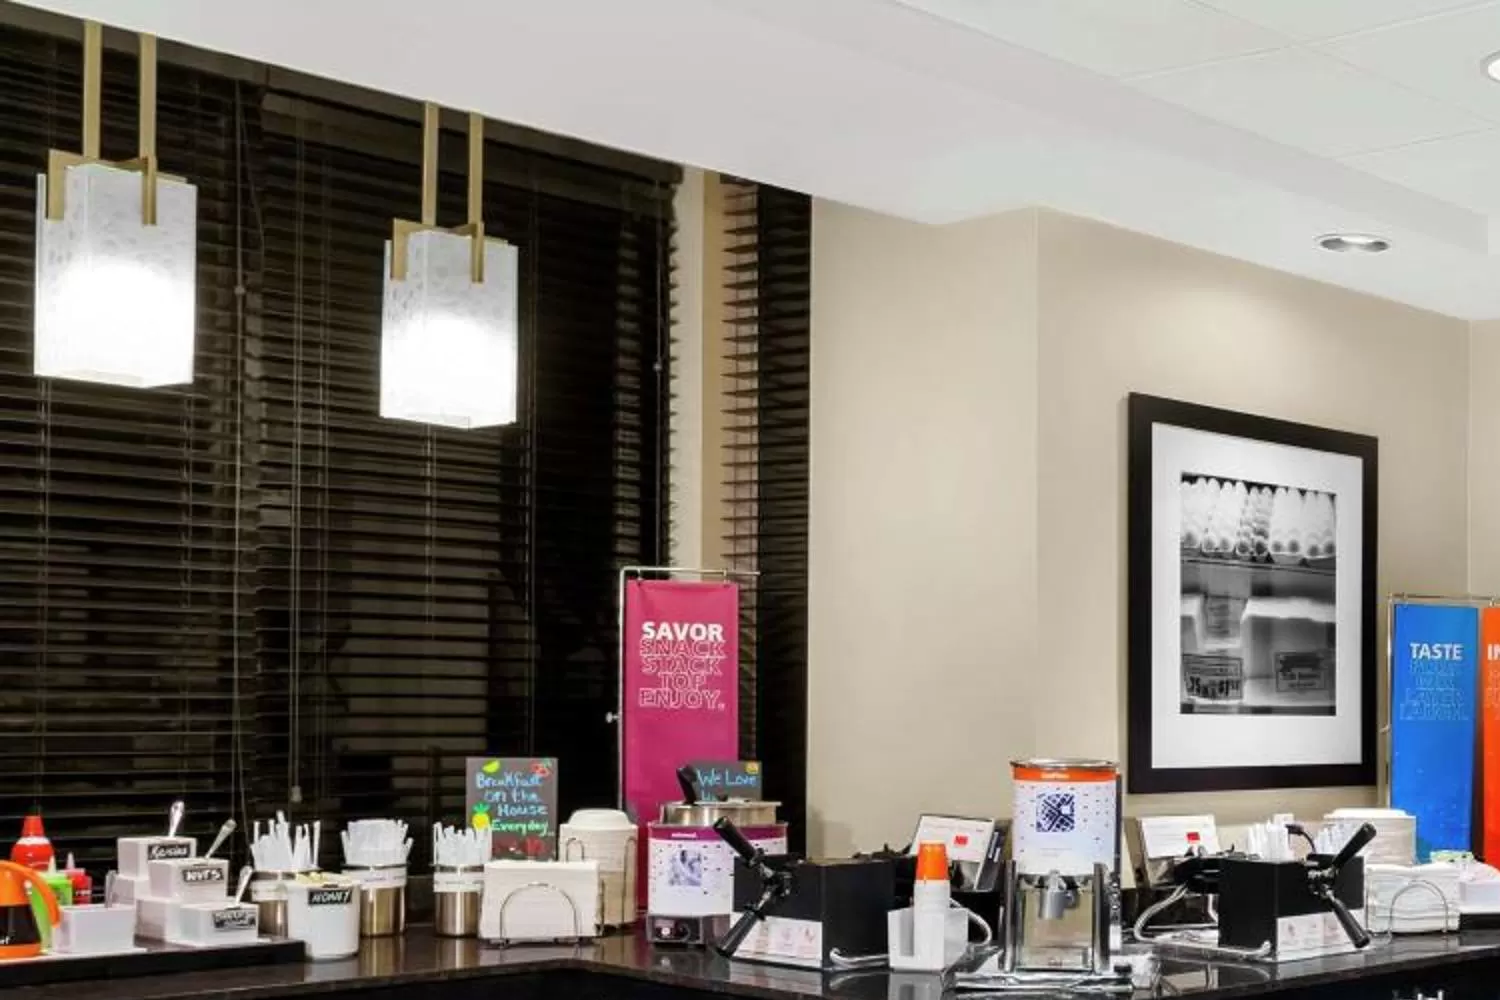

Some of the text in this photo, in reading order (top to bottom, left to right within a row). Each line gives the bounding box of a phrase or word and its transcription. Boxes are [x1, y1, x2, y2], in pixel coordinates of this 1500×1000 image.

[641, 621, 725, 642] SAVOR
[639, 640, 726, 658] SNACK
[1409, 642, 1464, 661] TASTE
[641, 656, 722, 675] STACK
[657, 672, 706, 691] TOP
[638, 688, 725, 710] ENJOY.
[476, 772, 542, 789] Breakfast
[696, 767, 757, 786] We Love
[484, 788, 540, 803] on the
[497, 803, 549, 817] House
